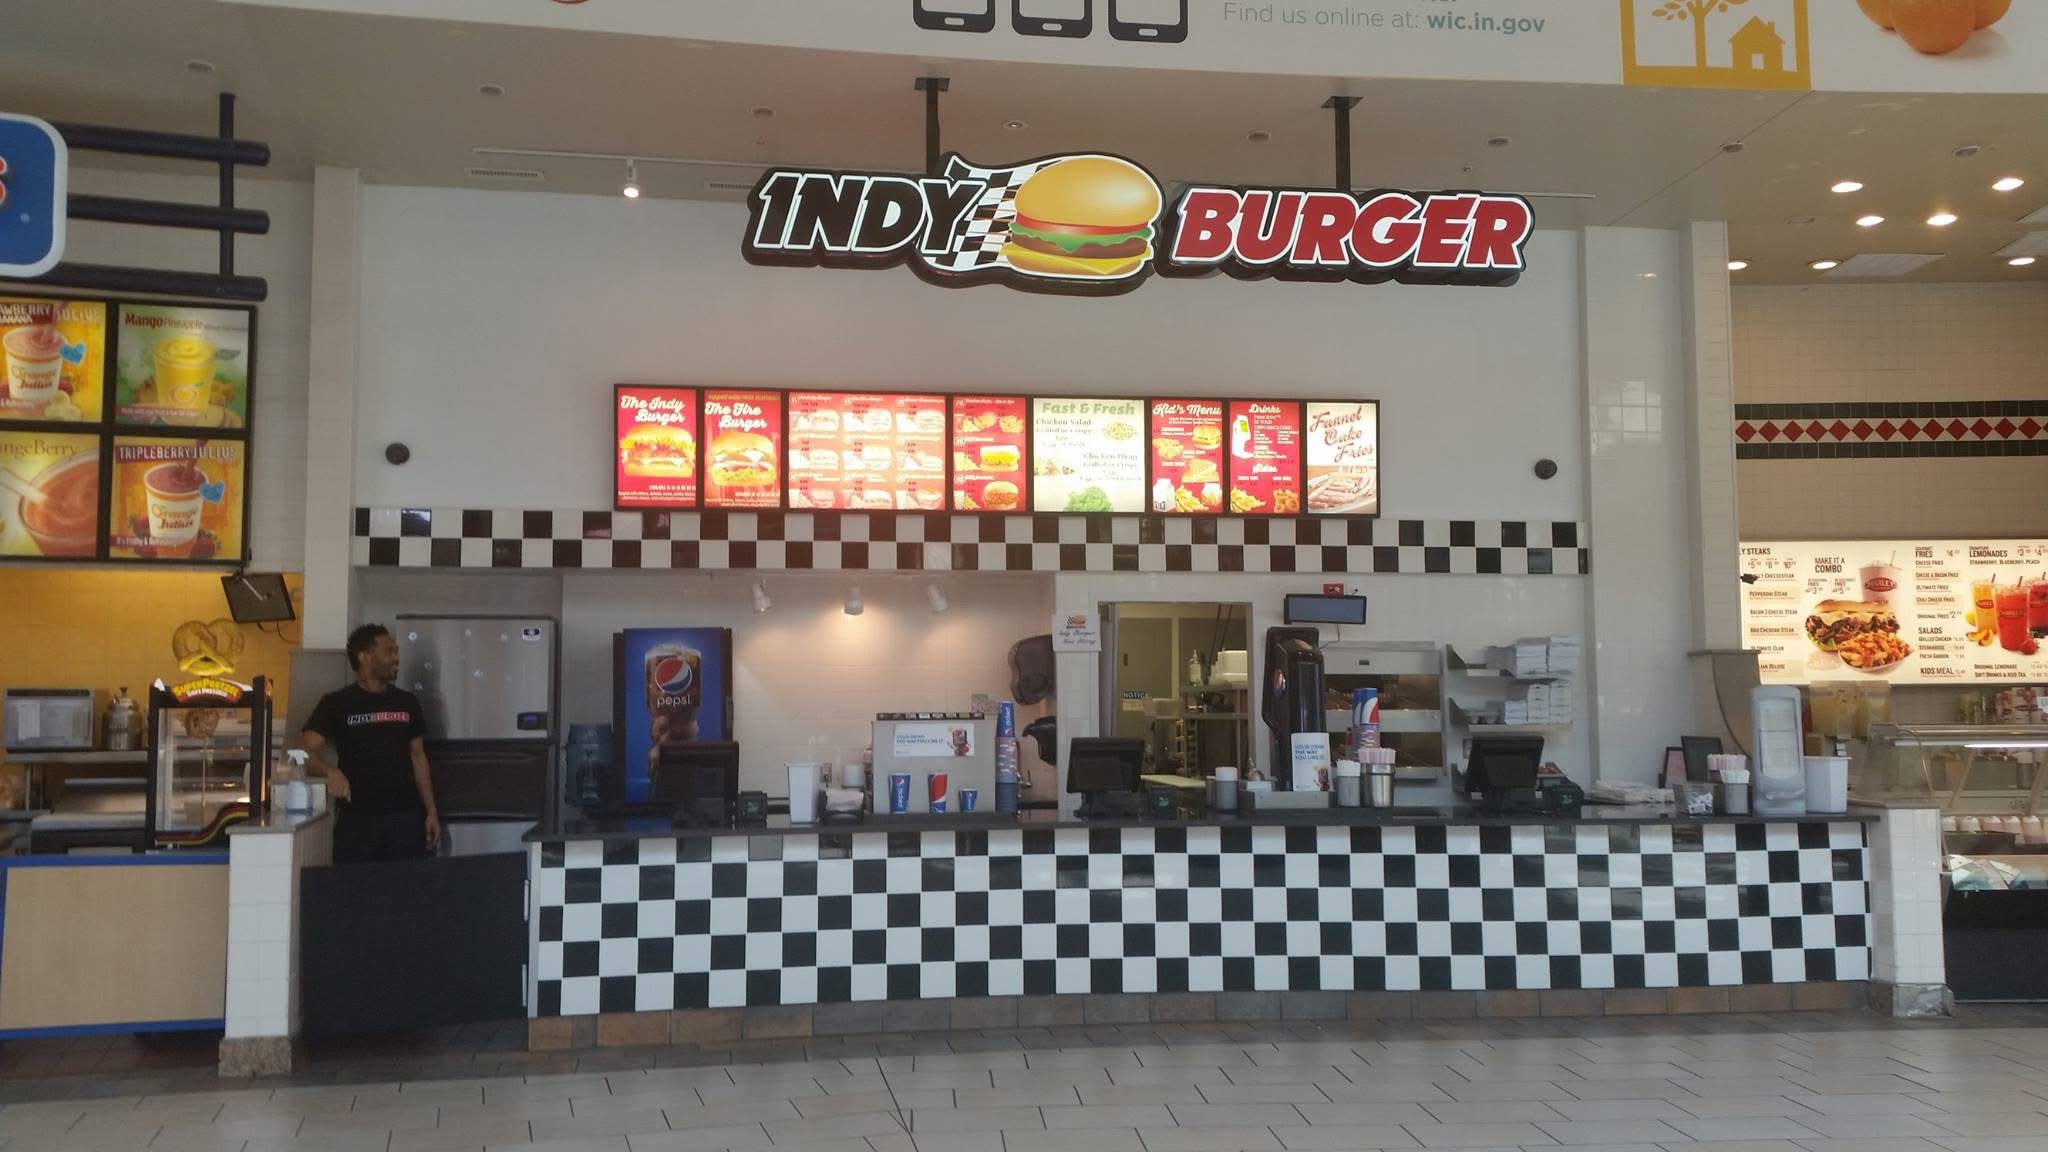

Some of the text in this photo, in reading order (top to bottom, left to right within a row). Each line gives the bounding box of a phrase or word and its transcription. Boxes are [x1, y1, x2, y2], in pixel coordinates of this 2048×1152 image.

[1223, 2, 1545, 35] Find us online at: wic.in.gov
[1170, 187, 1531, 269] BURGER
[621, 395, 686, 413] The Indy
[704, 401, 731, 415] The
[1042, 402, 1135, 416] Fast & Fresh
[1152, 403, 1222, 417] Kid's Menu
[1248, 403, 1281, 414] Drinks
[635, 408, 686, 426] Burger
[718, 414, 768, 433] Burger
[1070, 417, 1092, 426] Salad
[1310, 404, 1362, 432] Funnel
[1324, 425, 1362, 446] Cake
[0, 440, 80, 459] ngeBerry
[1334, 442, 1374, 463] Fries
[1746, 547, 1771, 556] STEAKS
[1969, 550, 2008, 558] LEMONADES
[1814, 564, 1843, 573] COMBO
[1920, 667, 1954, 675] KIDS MEAL
[656, 694, 692, 710] pepsi
